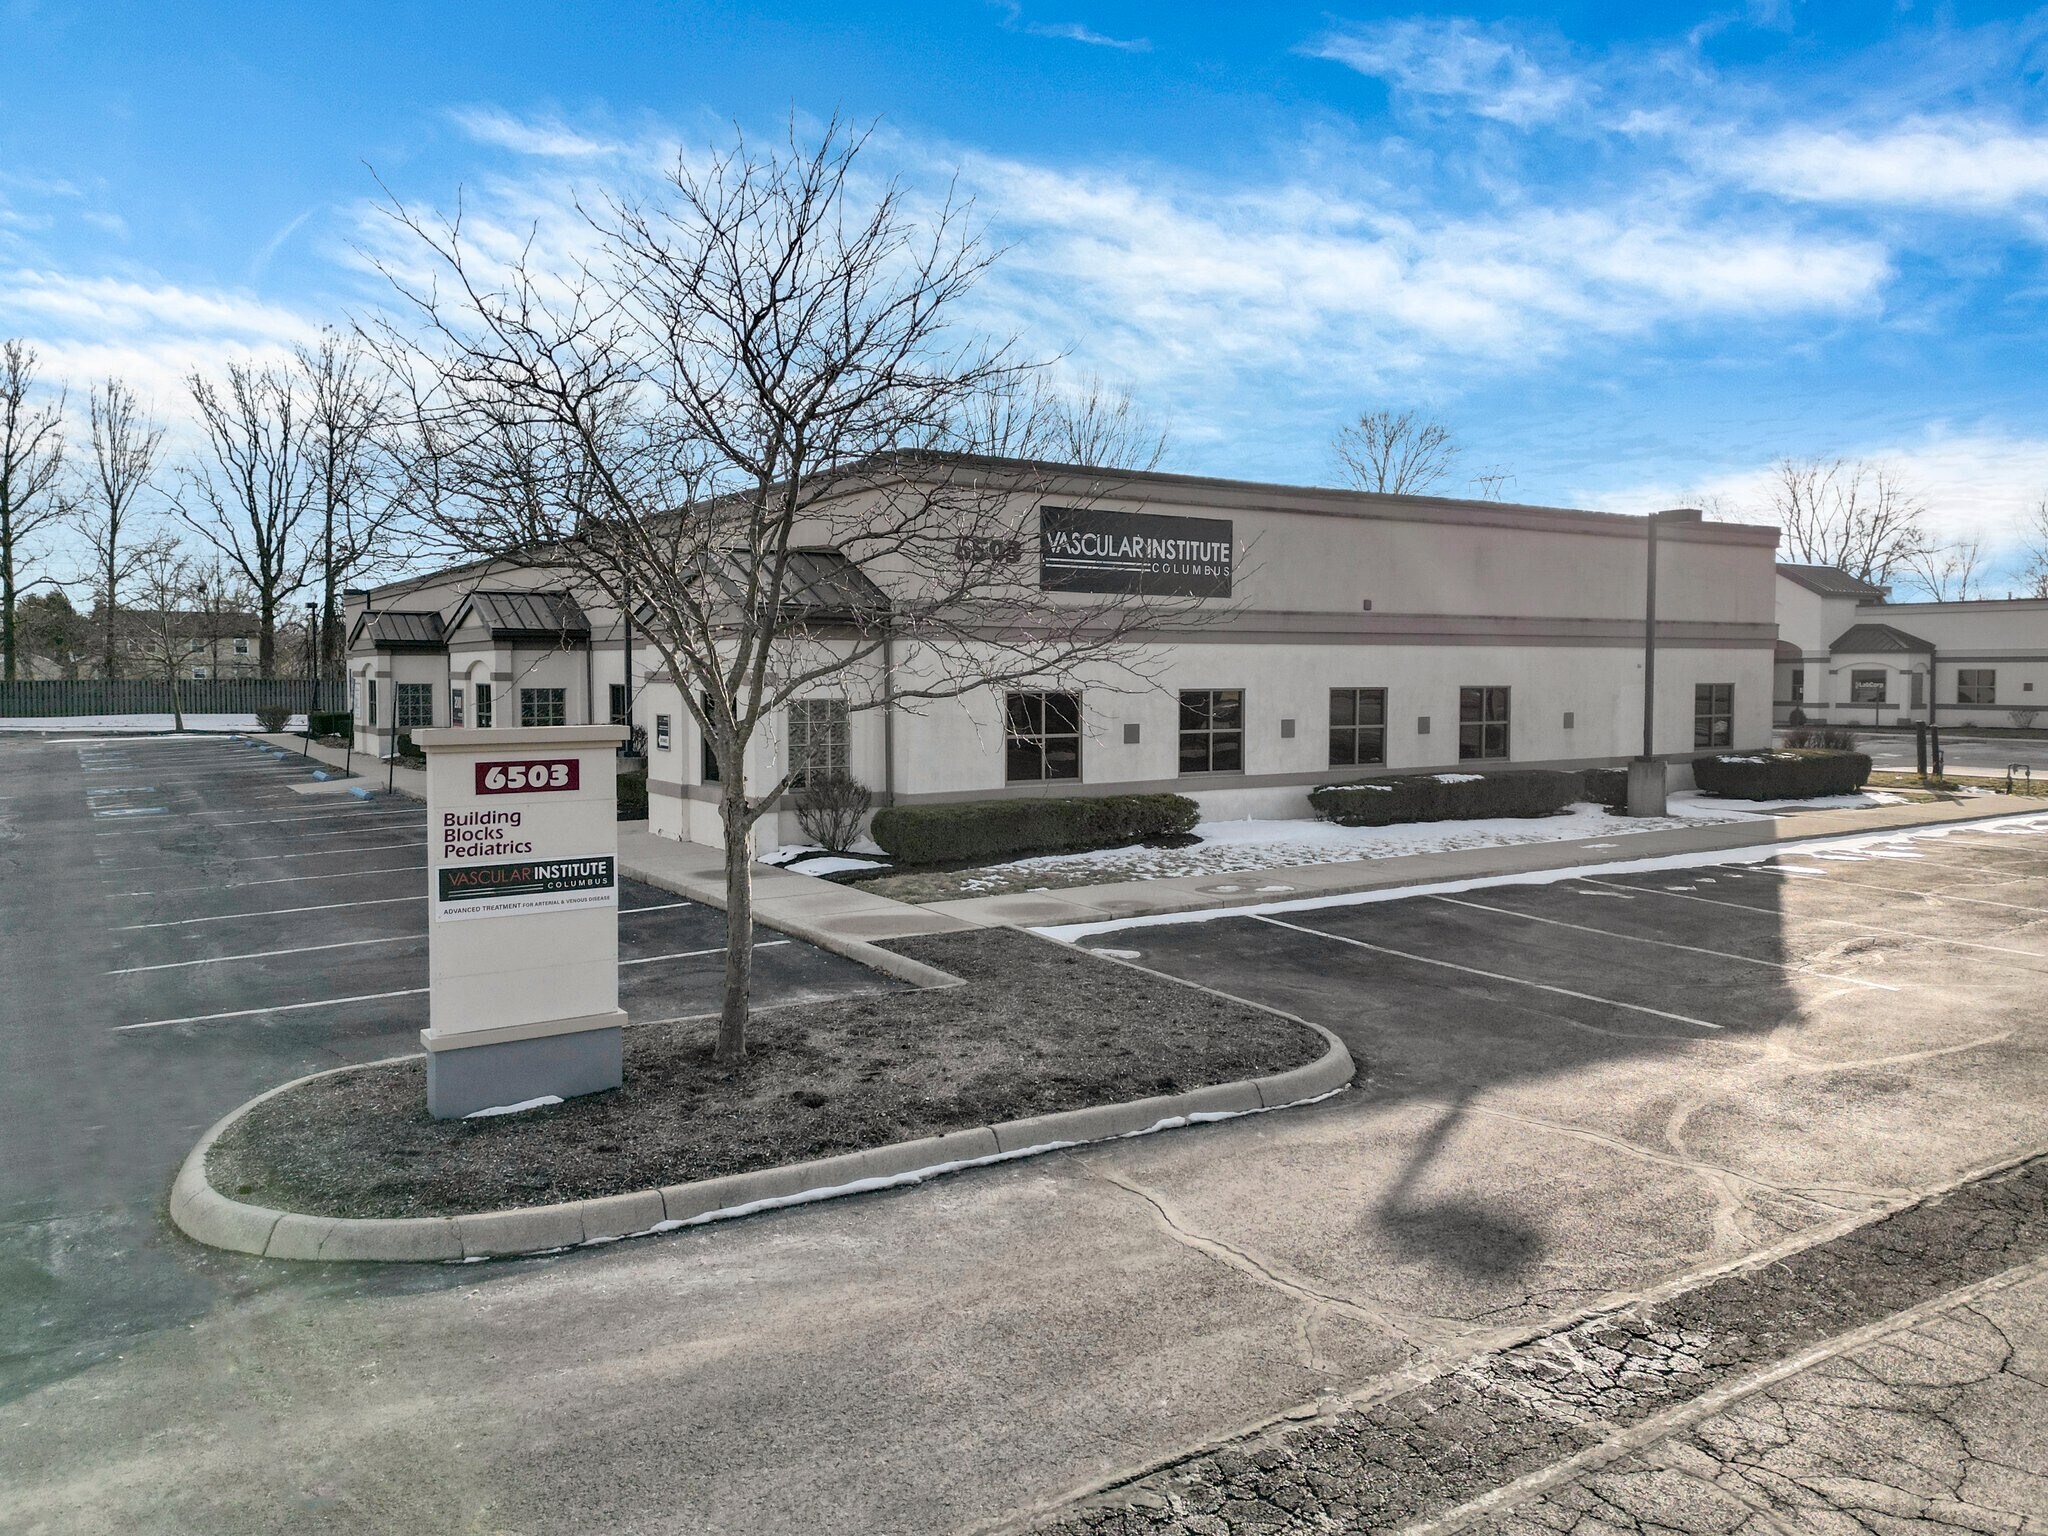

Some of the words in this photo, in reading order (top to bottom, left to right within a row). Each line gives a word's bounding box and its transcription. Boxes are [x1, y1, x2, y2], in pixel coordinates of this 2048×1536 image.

[1047, 531, 1144, 558] VASCULAR
[1147, 538, 1230, 562] INSTITUTE
[1152, 562, 1230, 577] COLUMBUS
[484, 764, 569, 790] 6503
[443, 810, 521, 828] Building
[444, 826, 504, 843] Blocks
[444, 841, 532, 859] Pediatrics
[448, 867, 531, 887] VASCULAR
[534, 861, 607, 880] INSTITUTE
[547, 877, 608, 890] COLUMBUS
[443, 906, 481, 915] ADVANCED
[482, 902, 522, 912] TREATMENT
